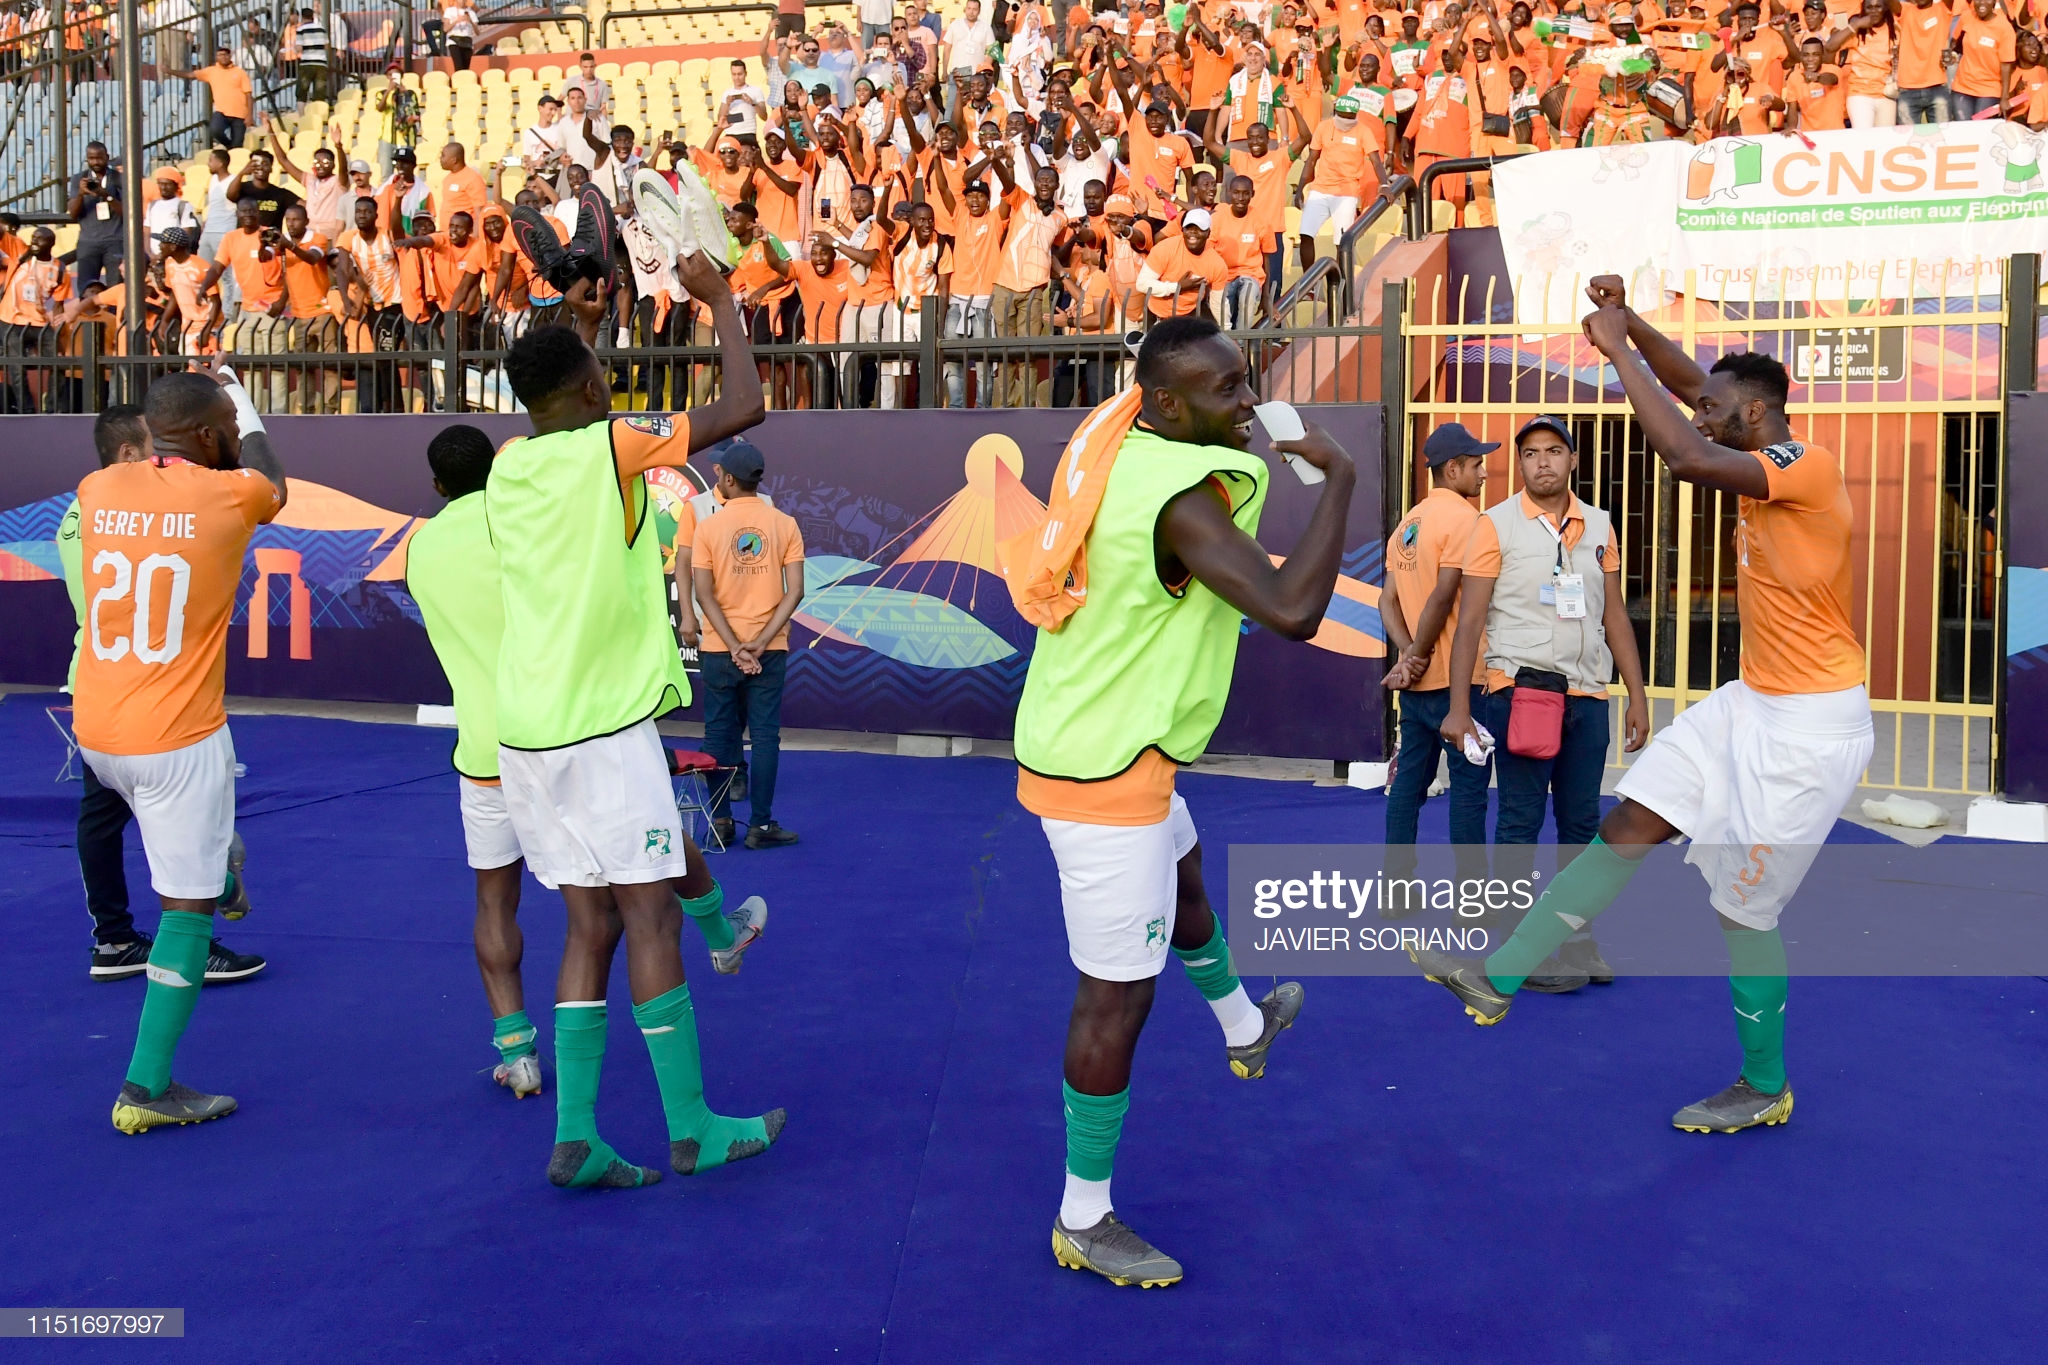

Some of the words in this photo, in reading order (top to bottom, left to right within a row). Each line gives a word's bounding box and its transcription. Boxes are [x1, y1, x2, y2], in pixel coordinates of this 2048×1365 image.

[1772, 144, 1980, 197] CNSE
[1678, 210, 1737, 226] Comité
[1742, 208, 1817, 225] National
[1822, 208, 1845, 222] de
[1850, 205, 1922, 221] Soutien
[1927, 205, 1962, 218] aux
[1701, 264, 1752, 283] Tous
[1767, 260, 1881, 282] ensemble
[658, 469, 690, 498] 2019
[93, 509, 155, 536] SEREY
[162, 513, 196, 538] DIE
[732, 565, 769, 575] SECURITY
[91, 549, 191, 664] 20
